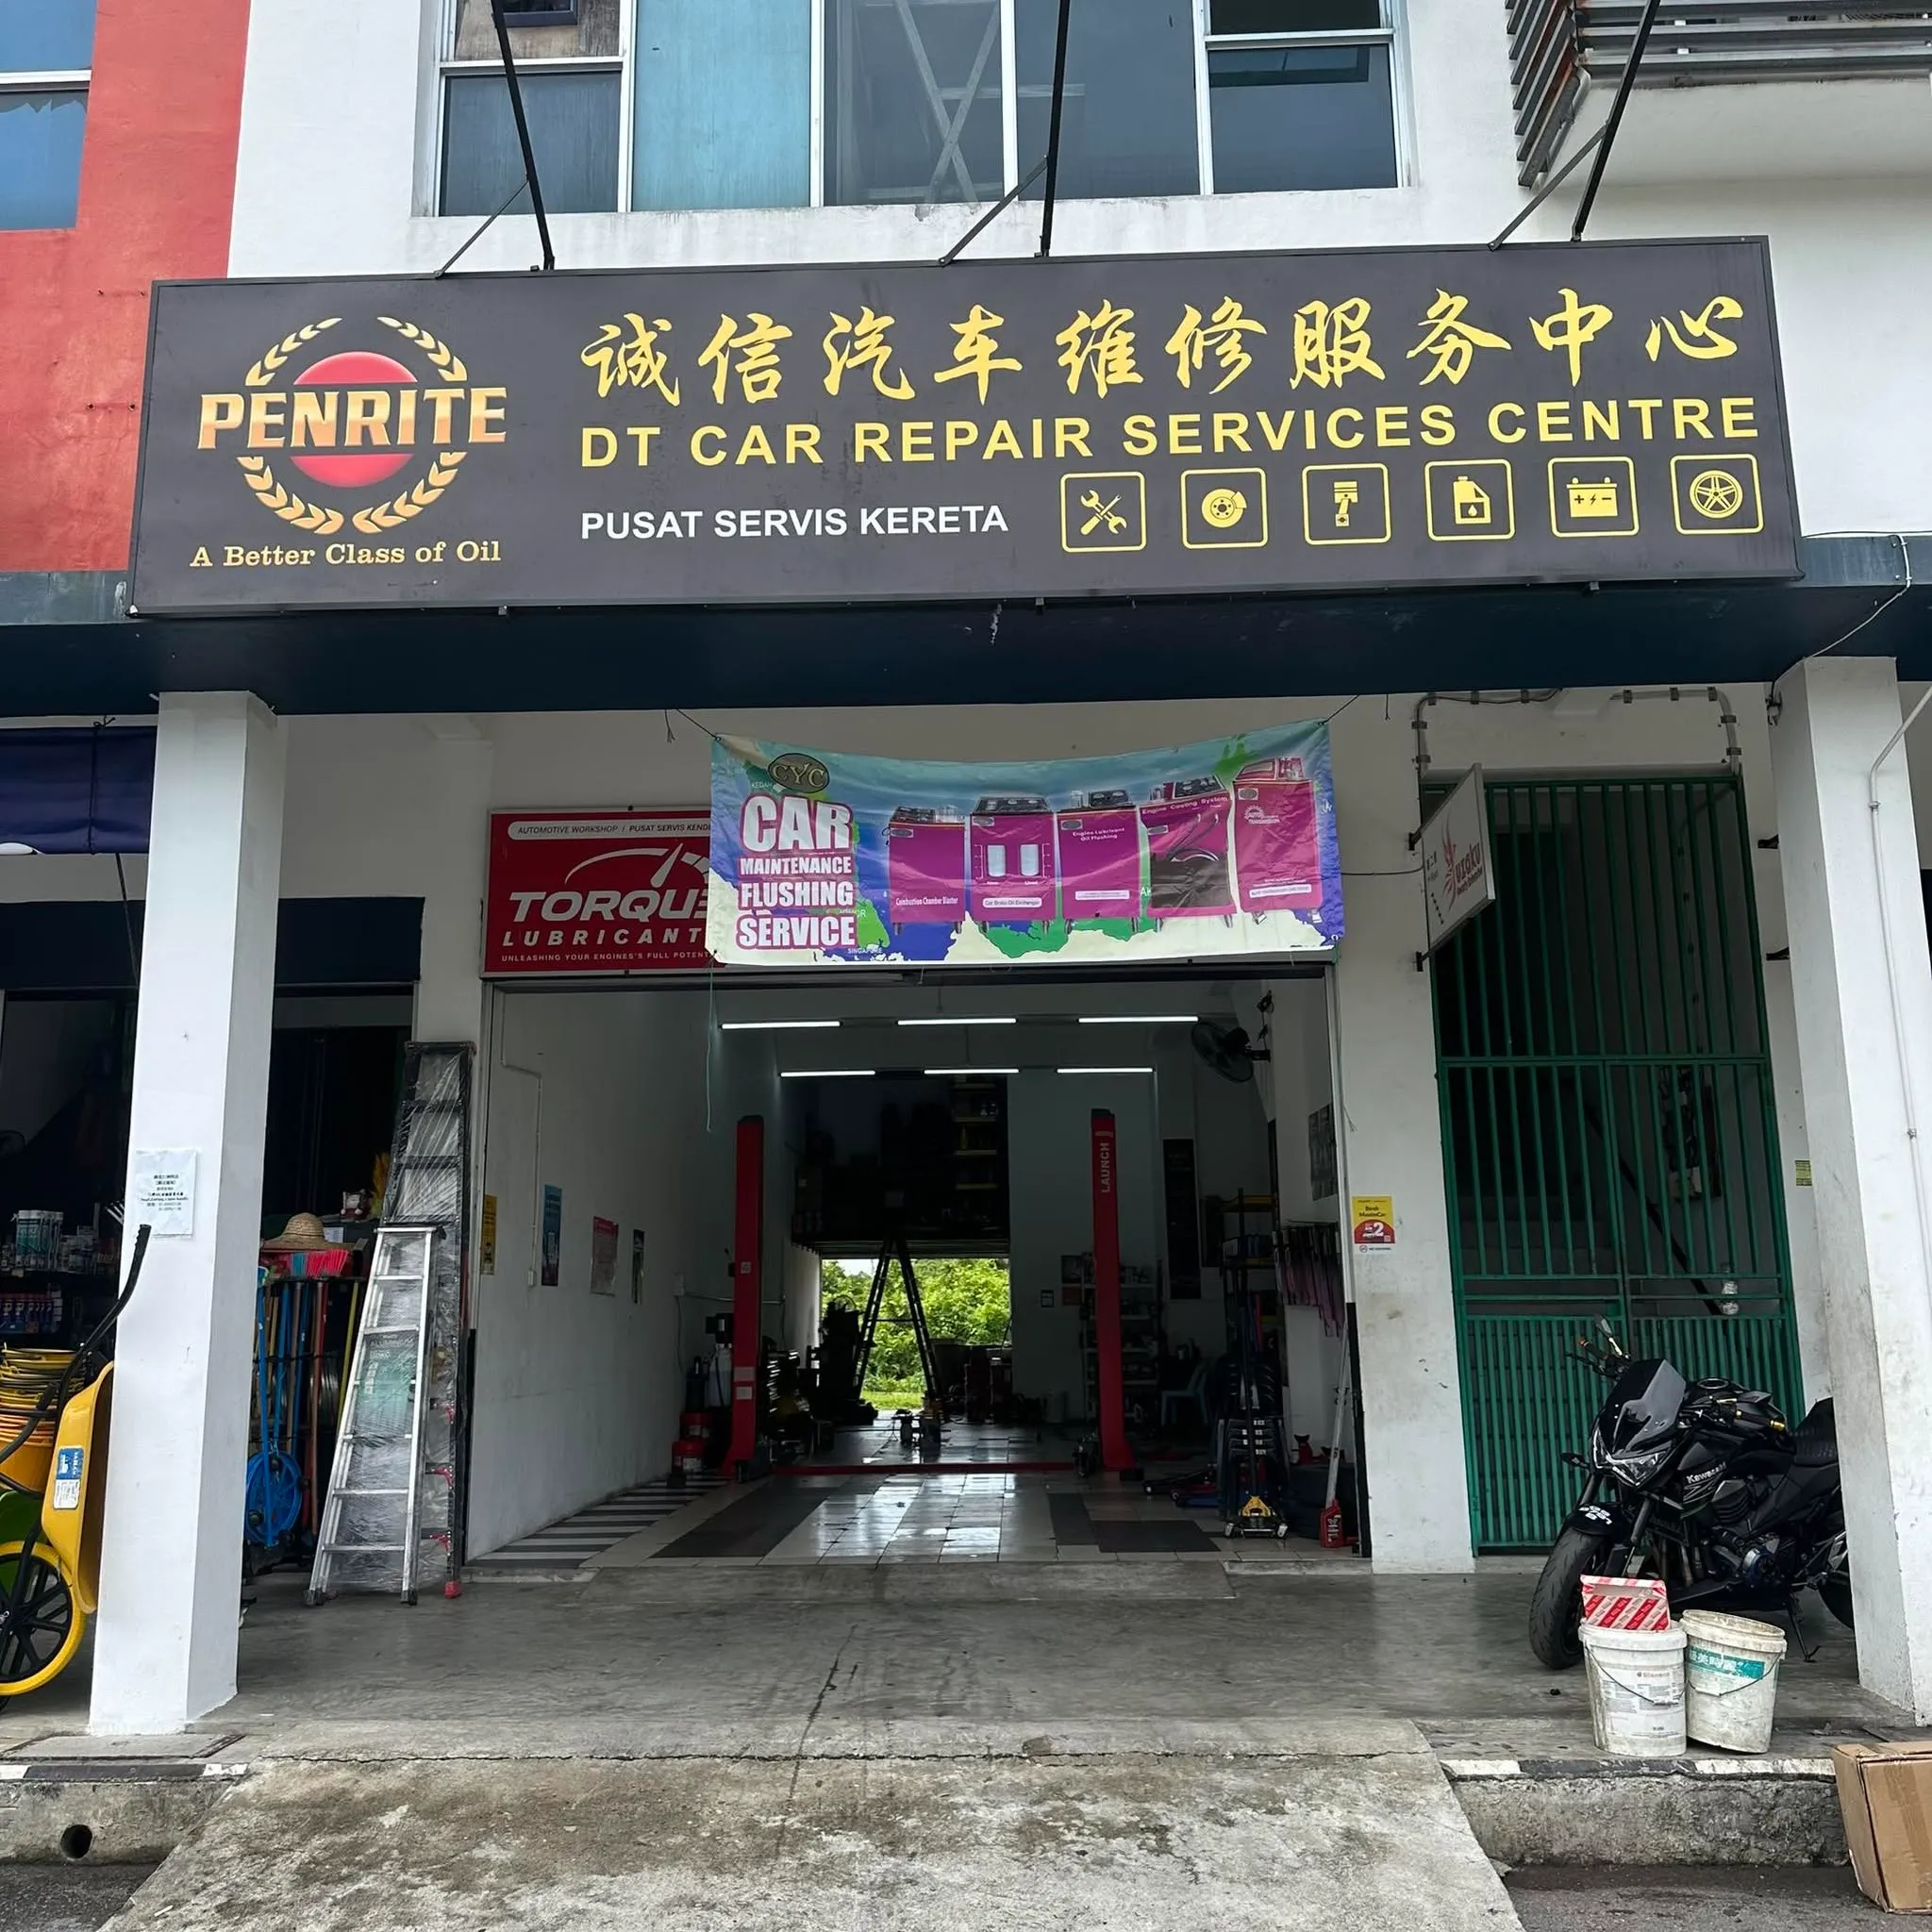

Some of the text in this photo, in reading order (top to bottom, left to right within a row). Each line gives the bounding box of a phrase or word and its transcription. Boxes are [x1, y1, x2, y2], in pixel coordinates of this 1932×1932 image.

[580, 289, 1744, 407] 诚信汽车维修服务中心
[197, 386, 508, 450] PENRITE
[581, 396, 1759, 467] DT CAR REPAIR SERVICES CENTRE
[581, 505, 1009, 540] PUSAT SERVIS KERETA
[190, 541, 502, 567] A Better Class of Oil
[772, 761, 824, 787] CYC
[517, 825, 570, 835] AUTOMOTIVE
[572, 824, 619, 835] WORKSHOP
[629, 824, 655, 833] PUSAT
[657, 823, 686, 832] SERVIS
[742, 795, 852, 853] CAR
[740, 856, 852, 875] MAINTENANCE
[741, 881, 854, 908] FLUSHING
[739, 916, 856, 946] SERVICE
[502, 954, 561, 962] UNLEASHING
[1099, 1142, 1110, 1193] LAUNCH
